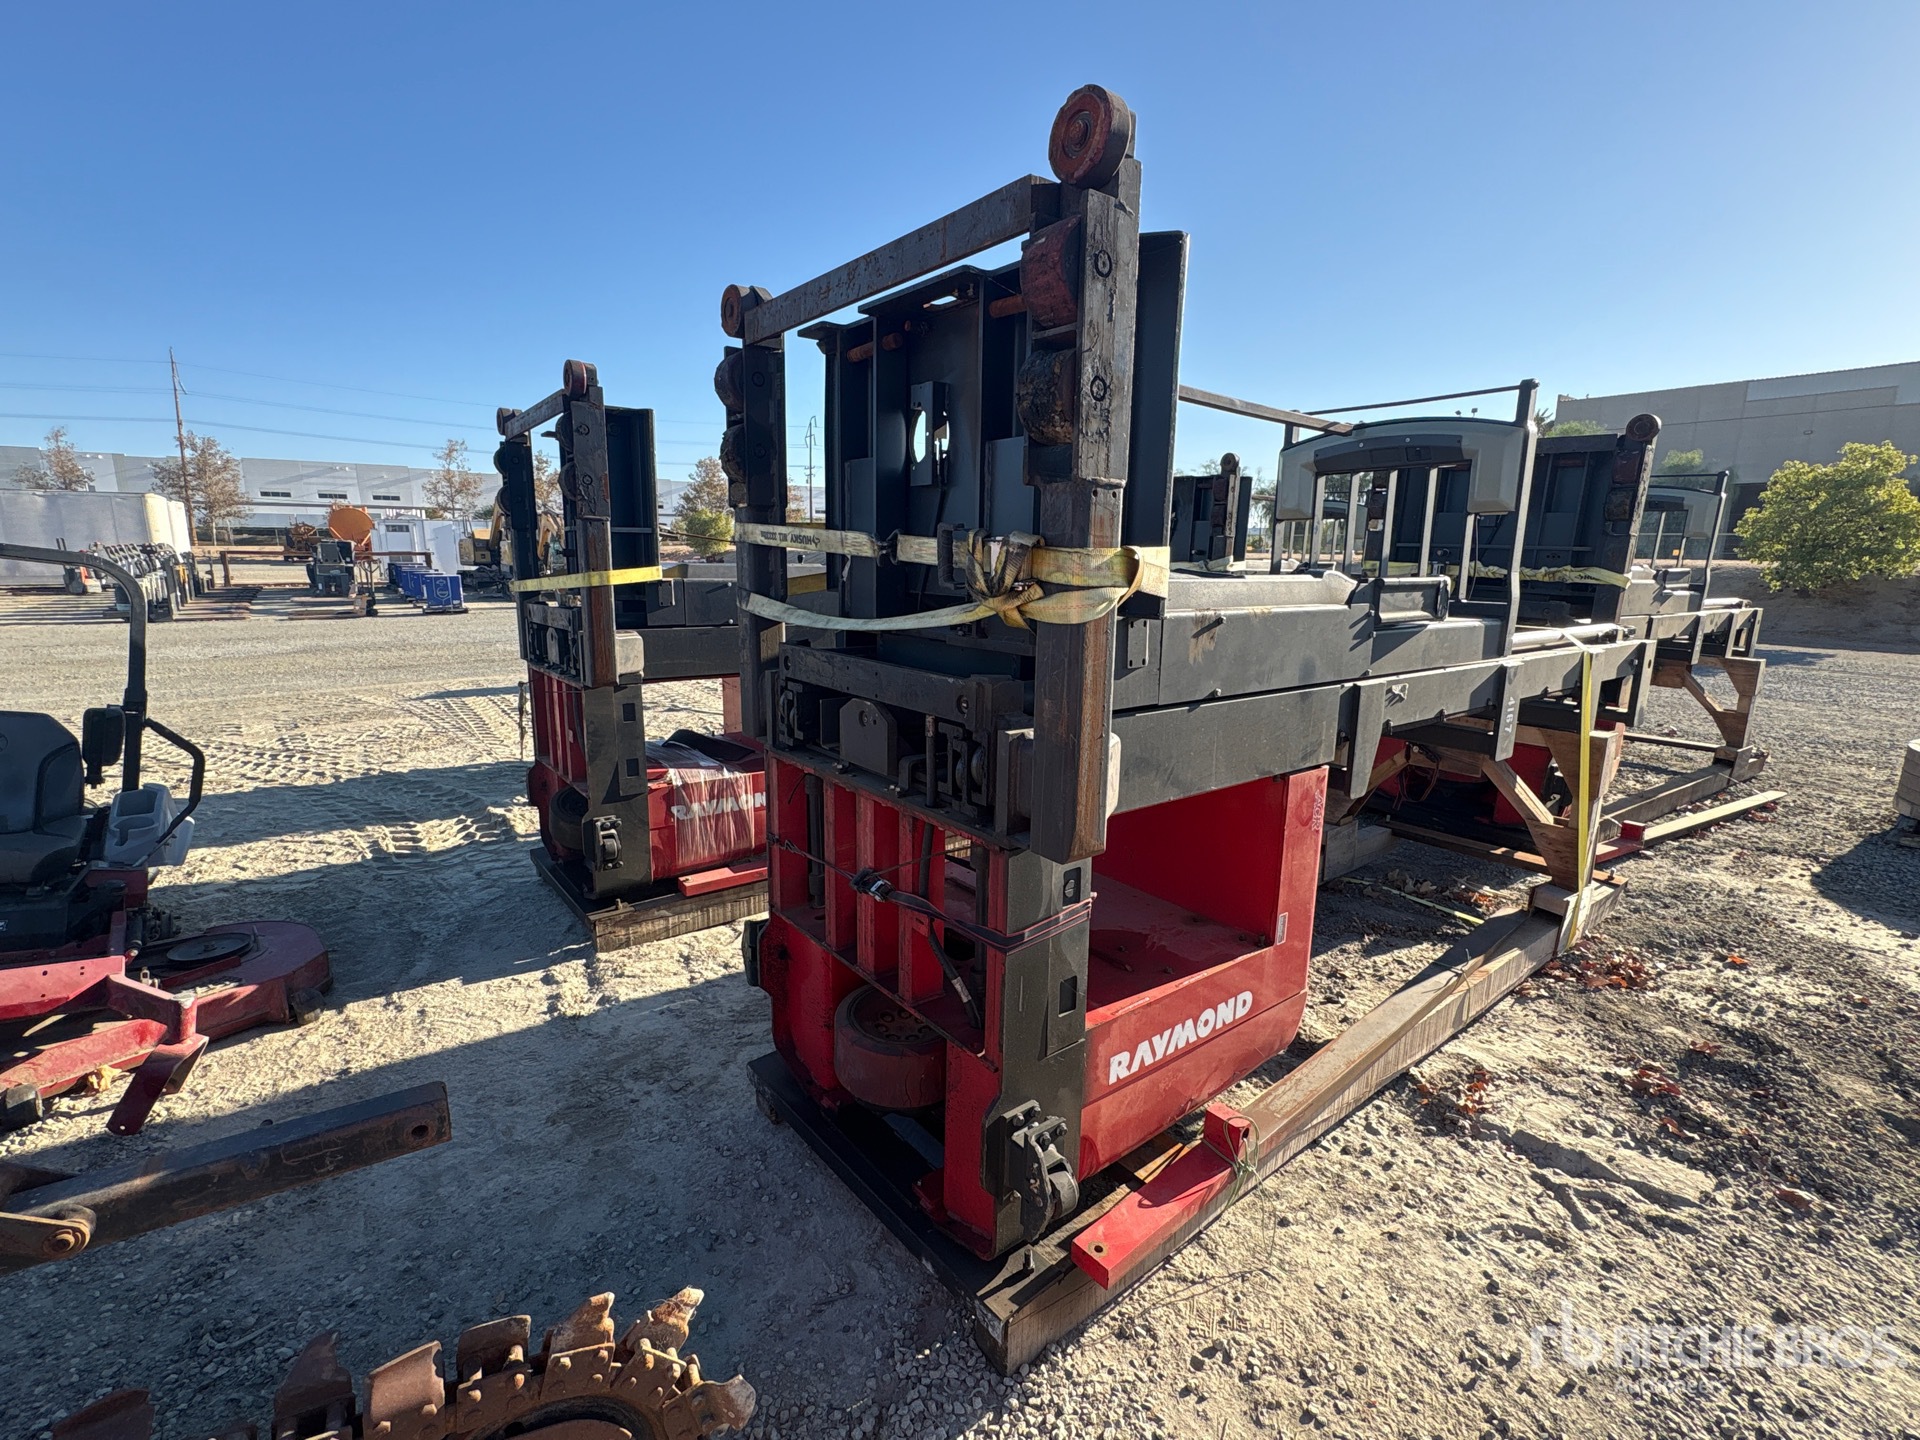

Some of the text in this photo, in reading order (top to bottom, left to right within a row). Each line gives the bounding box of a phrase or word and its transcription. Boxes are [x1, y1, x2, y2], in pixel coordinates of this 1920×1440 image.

[790, 533, 813, 546] HUSKY
[670, 791, 766, 820] RAYMON
[1108, 990, 1254, 1086] RAYMOND
